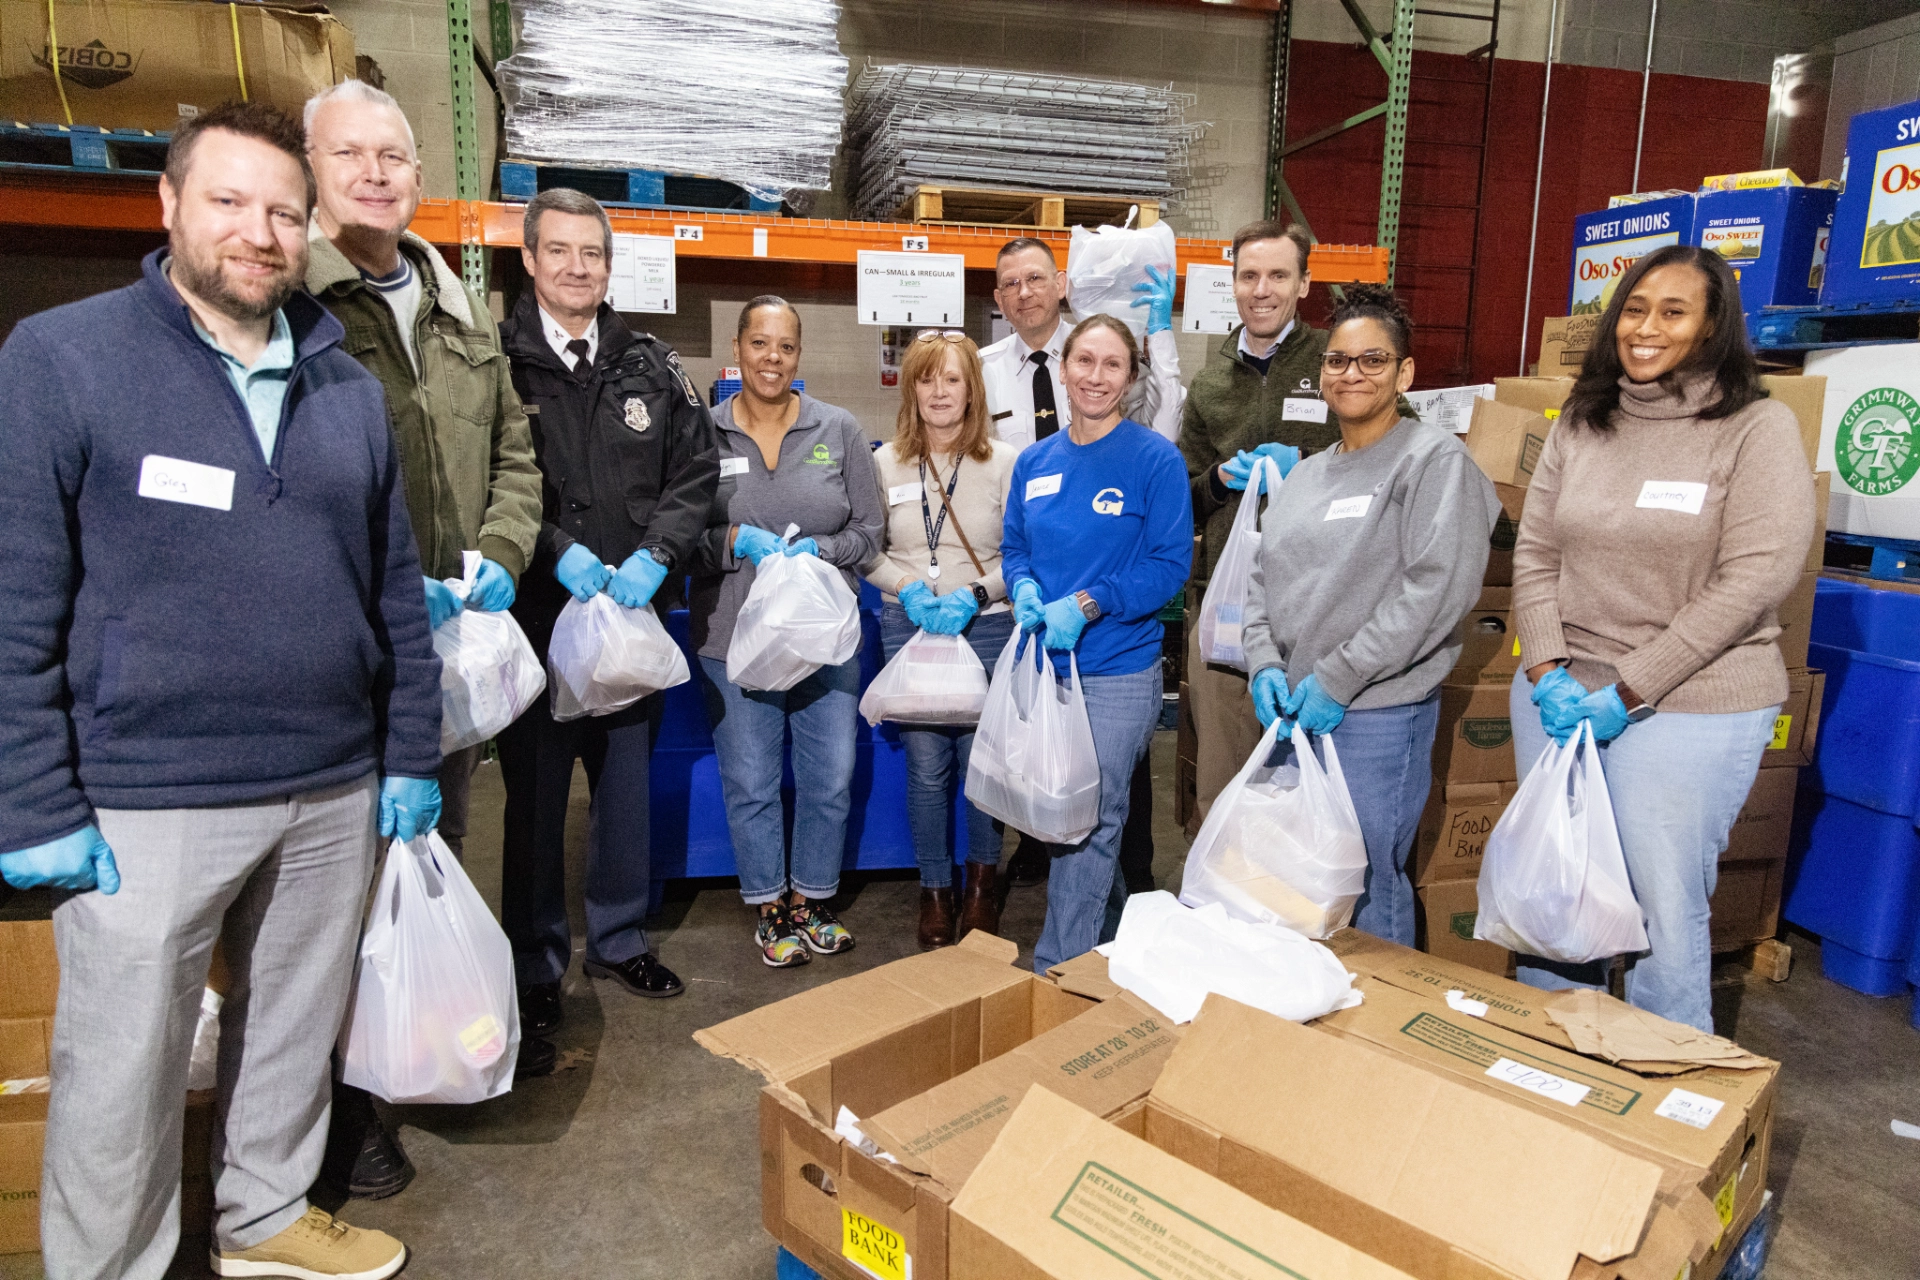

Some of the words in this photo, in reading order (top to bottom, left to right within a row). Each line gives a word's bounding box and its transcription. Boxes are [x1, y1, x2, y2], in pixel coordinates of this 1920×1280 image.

[1740, 176, 1774, 187] Cheerios
[1585, 220, 1621, 242] SWEET
[1623, 211, 1671, 235] ONIONS
[1708, 218, 1732, 227] SWEET
[1733, 217, 1760, 225] ONIONS
[679, 228, 688, 238] F
[691, 229, 699, 239] 4
[906, 239, 914, 249] F
[916, 241, 924, 250] 5
[917, 270, 955, 278] IRREGULAR
[1285, 403, 1315, 415] Brian
[1844, 390, 1920, 427] GRIMMWAY
[154, 472, 187, 493] Greg
[1847, 472, 1902, 494] FARMS
[1448, 810, 1492, 848] FOOD
[1454, 839, 1484, 859] BAN
[1423, 976, 1442, 988] TO
[1060, 1051, 1102, 1076] STORE
[1094, 1044, 1114, 1060] AT
[1125, 1026, 1147, 1040] TO
[1091, 1065, 1116, 1081] KEEP
[1113, 1035, 1171, 1069] REFRIGERATED
[1505, 1063, 1563, 1092] 400
[847, 1211, 898, 1250] FOOD
[1129, 1210, 1168, 1238] FRESH
[849, 1228, 899, 1272] BANK
